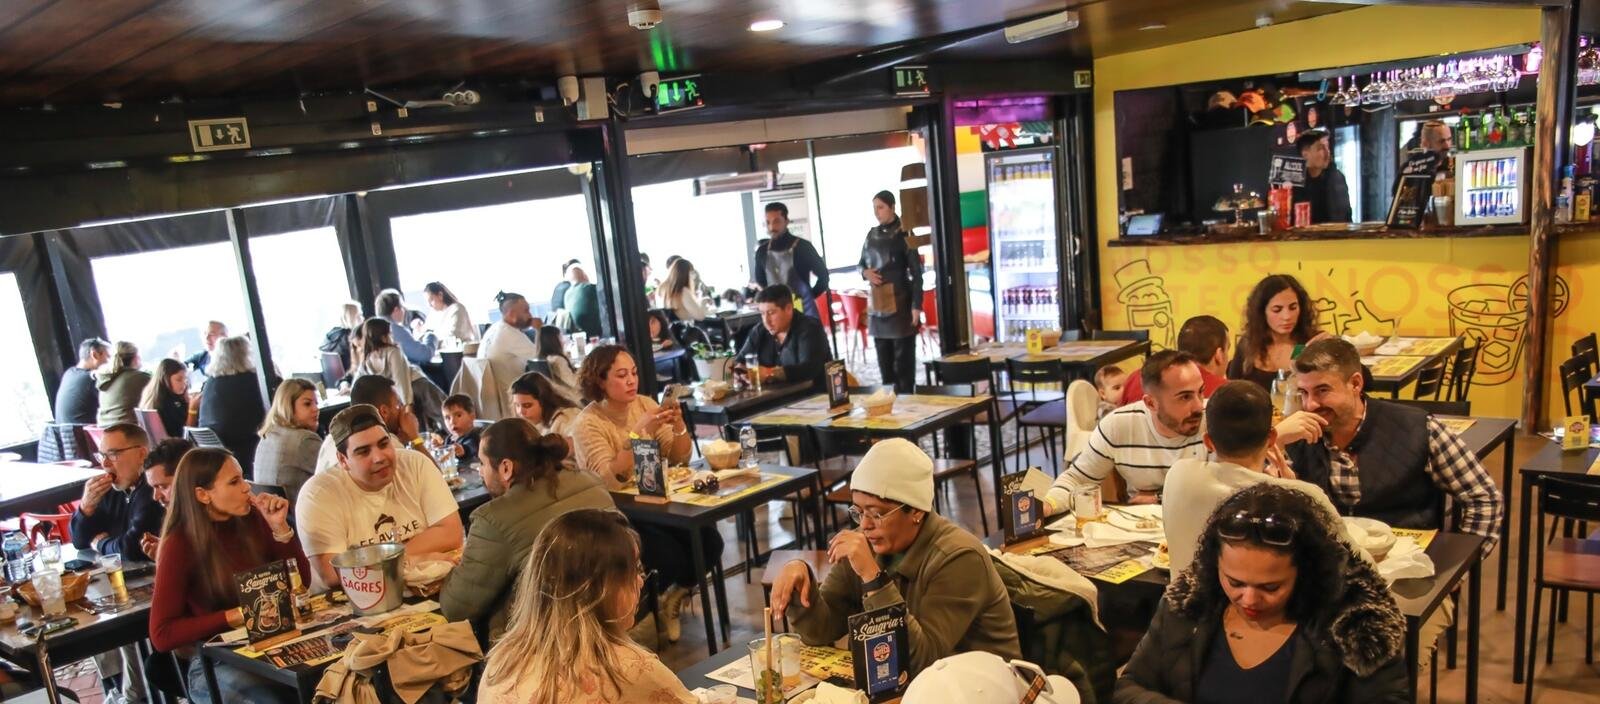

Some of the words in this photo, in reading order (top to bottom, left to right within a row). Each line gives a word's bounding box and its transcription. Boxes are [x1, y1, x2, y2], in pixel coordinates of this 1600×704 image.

[244, 574, 279, 593] Sangria
[341, 576, 382, 593] SAGRES
[857, 618, 900, 641] Sangria
